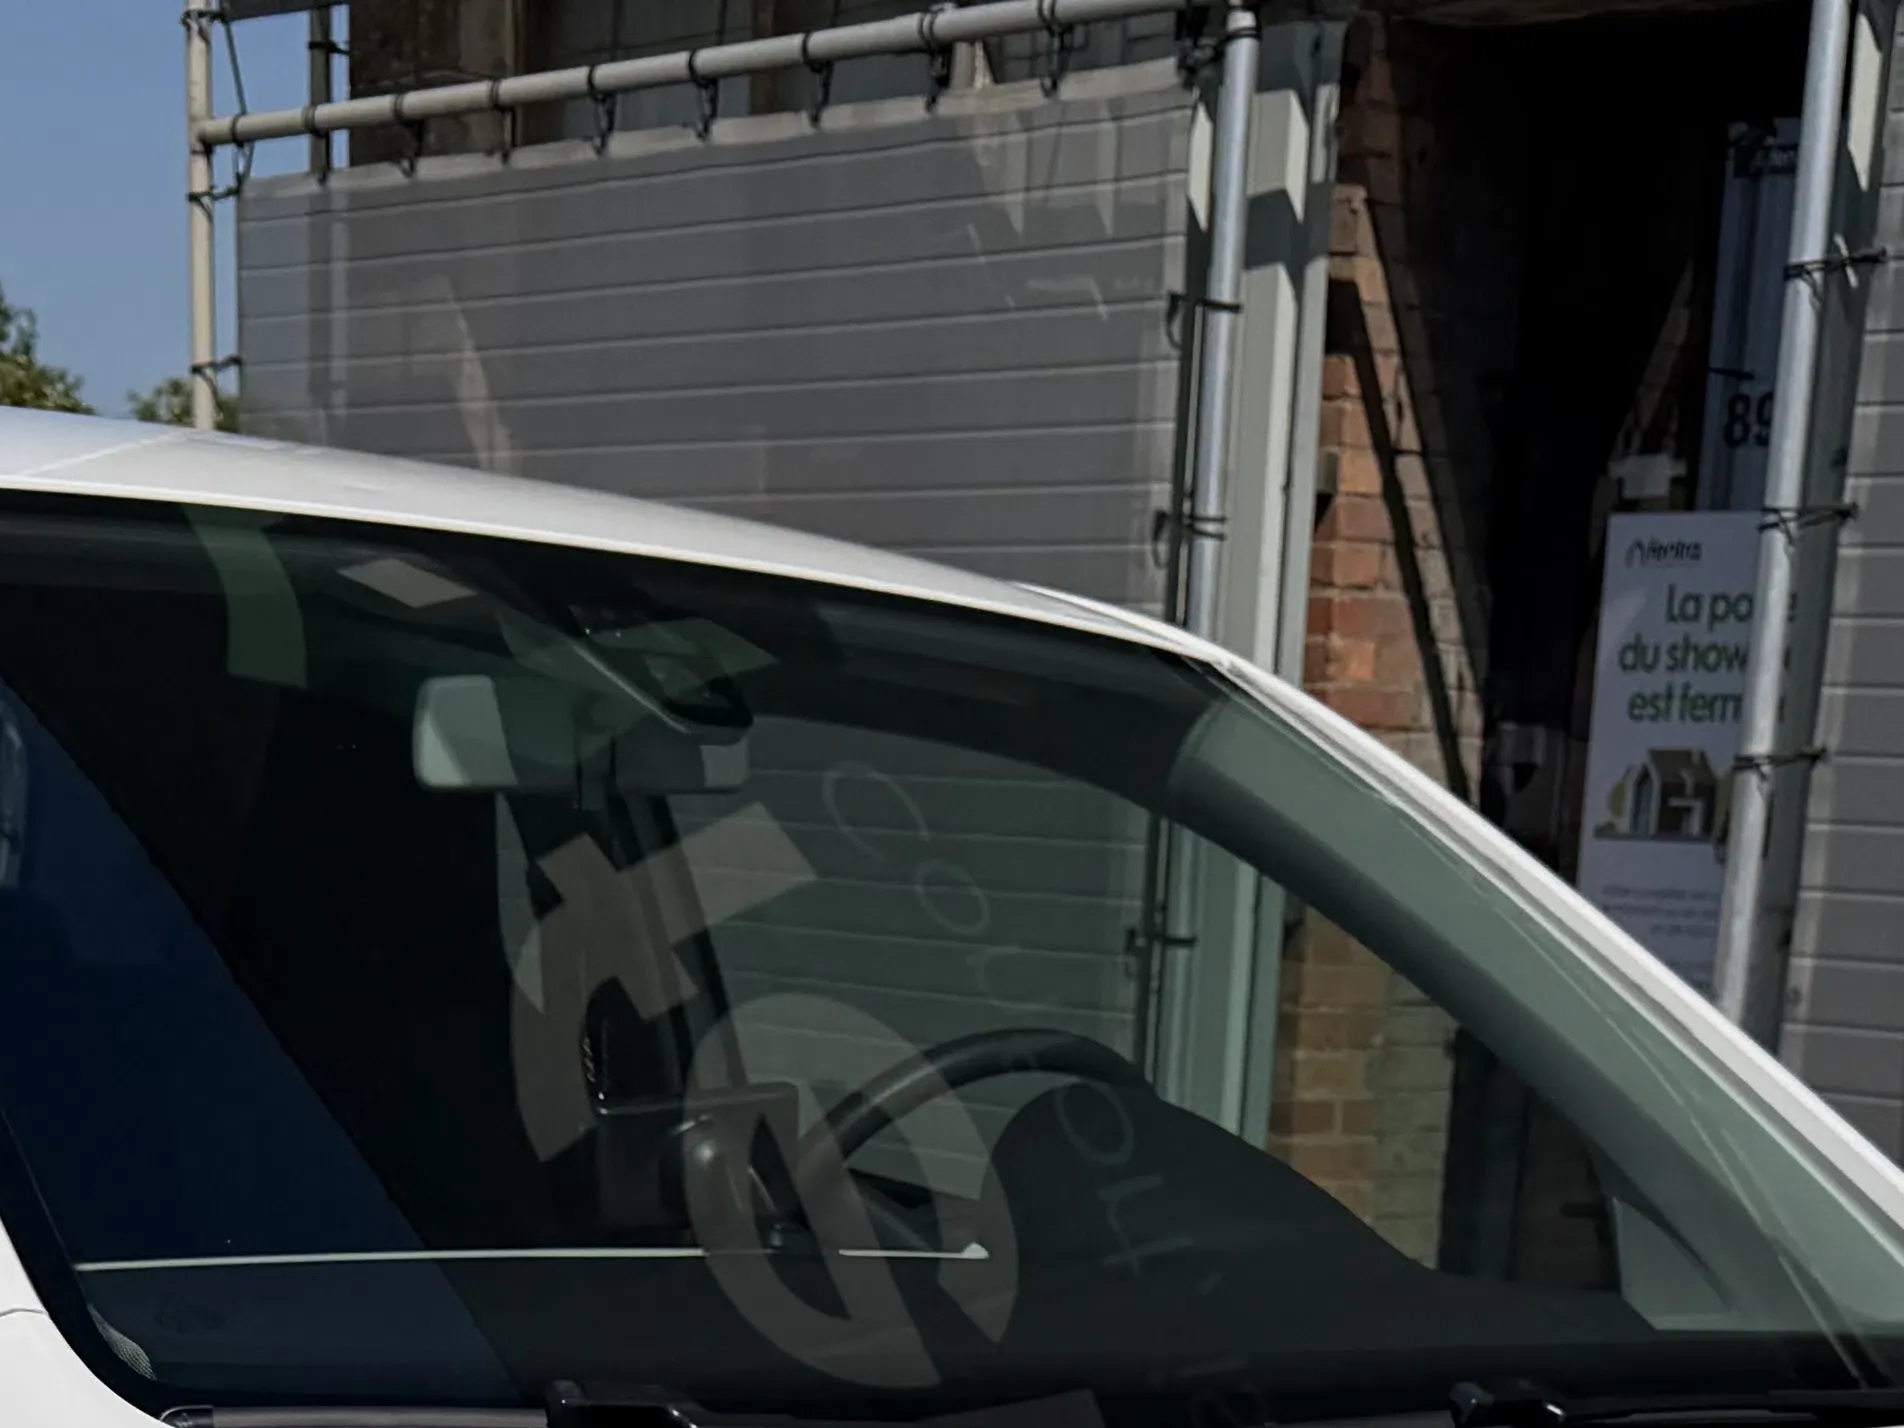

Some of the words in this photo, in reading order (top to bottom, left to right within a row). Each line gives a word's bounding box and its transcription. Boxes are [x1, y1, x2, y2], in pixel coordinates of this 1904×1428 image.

[1666, 584, 1702, 623] La
[1619, 632, 1660, 673] du
[1628, 682, 1674, 722] est
